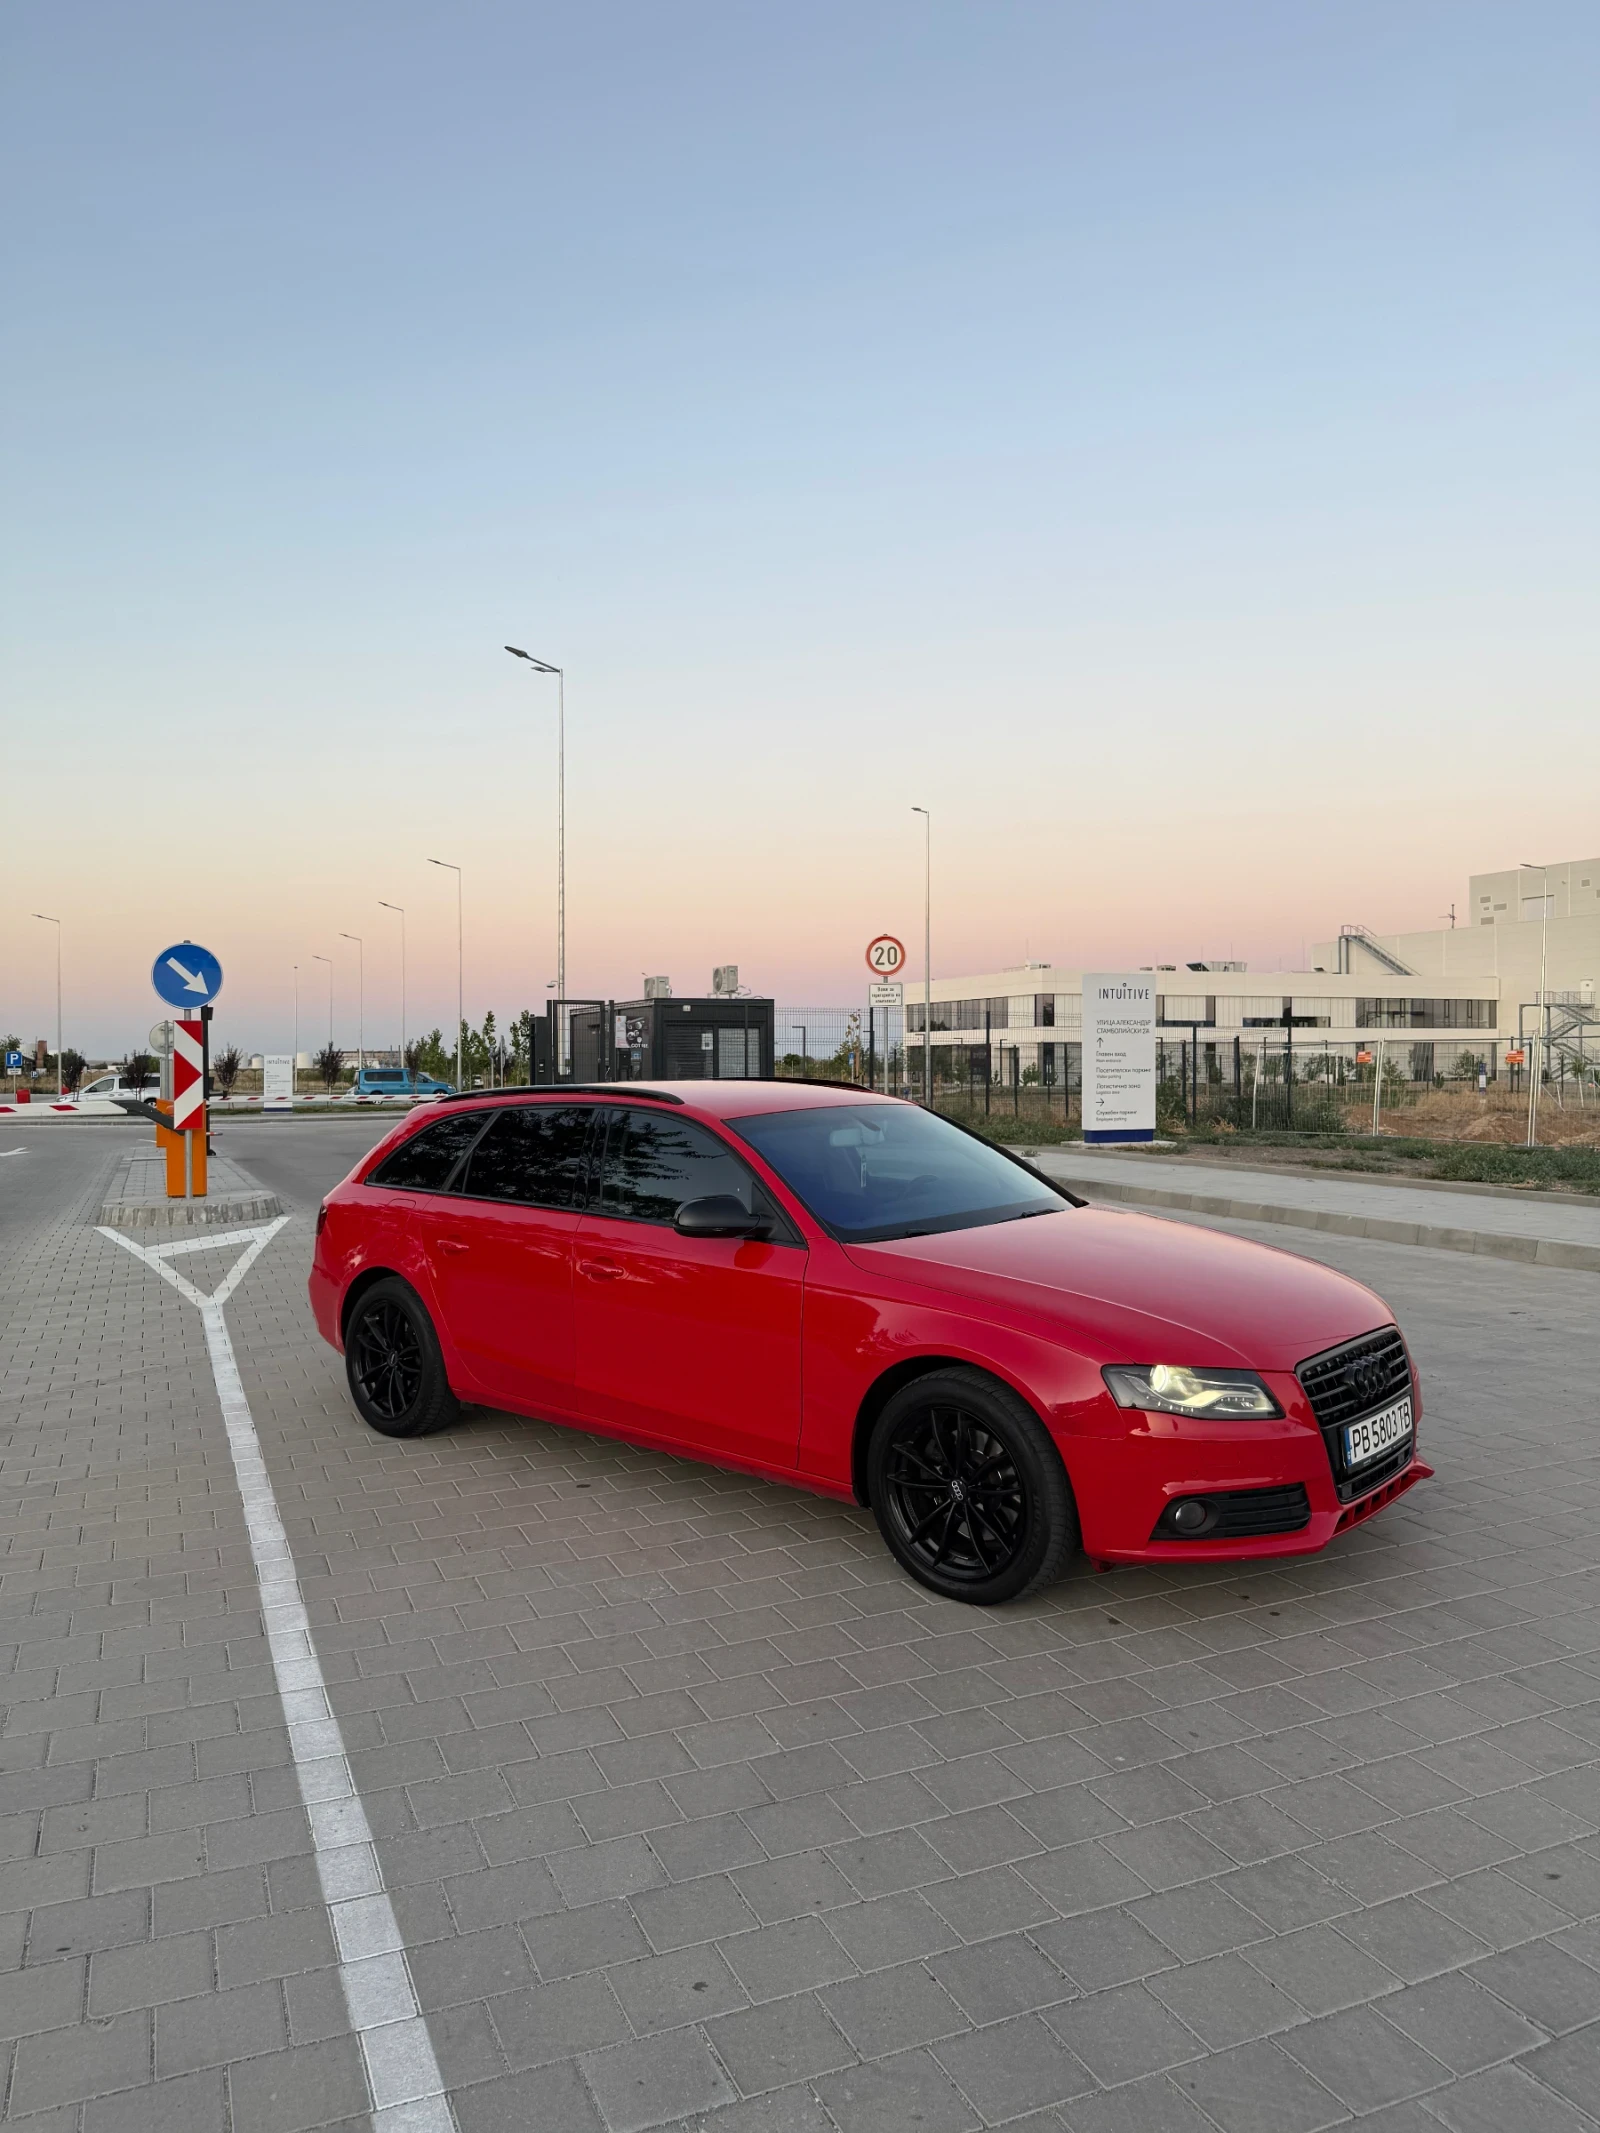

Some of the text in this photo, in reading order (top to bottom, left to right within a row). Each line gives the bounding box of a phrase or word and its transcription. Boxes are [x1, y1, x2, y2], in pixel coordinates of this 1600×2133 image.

[874, 946, 898, 966] 20
[1098, 983, 1150, 1000] INTUITIVE
[10, 1053, 19, 1065] P
[1352, 1401, 1411, 1458] PB 5803 TB
